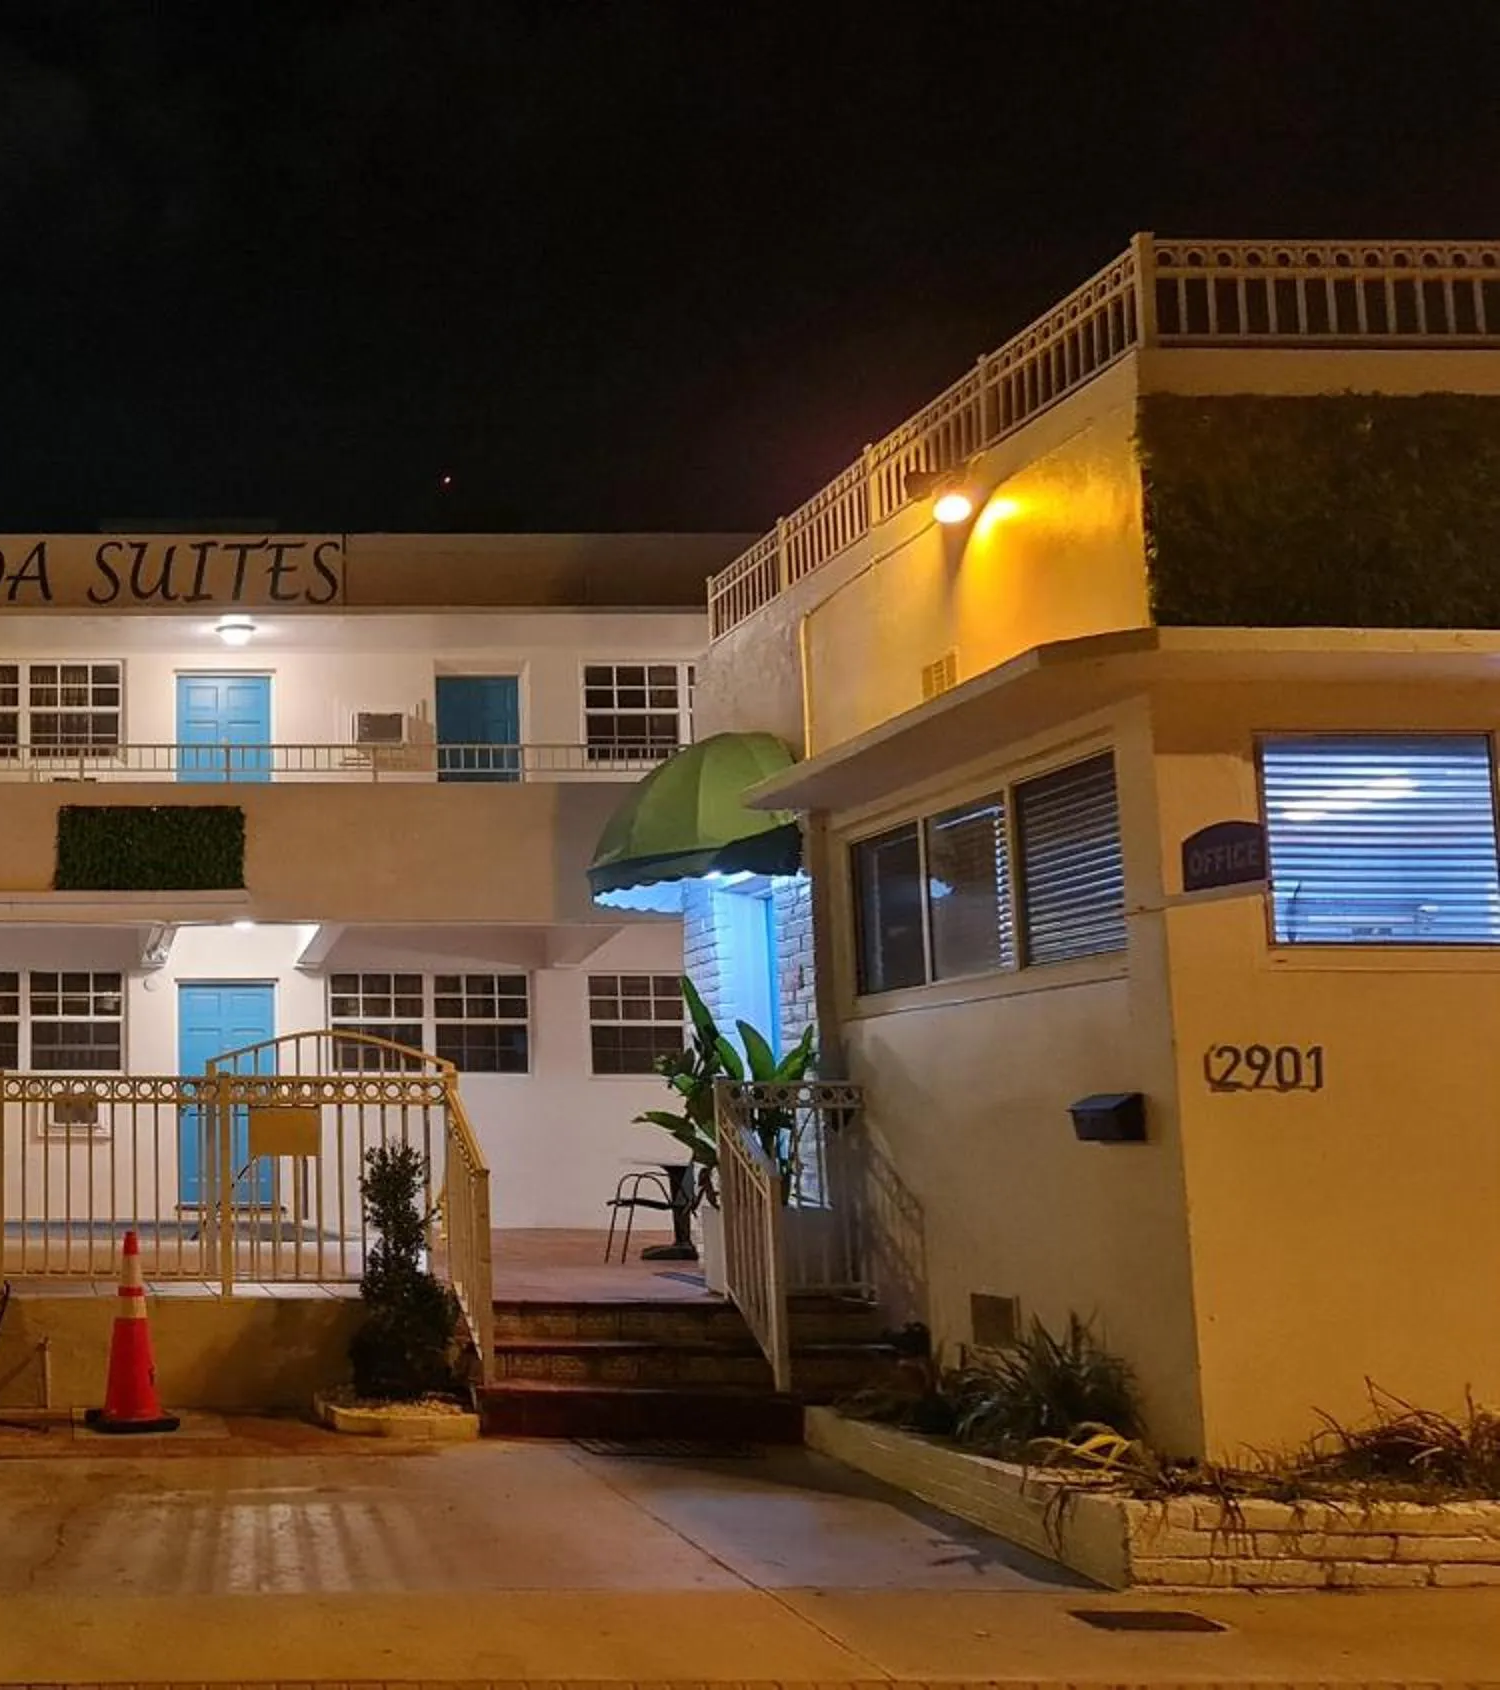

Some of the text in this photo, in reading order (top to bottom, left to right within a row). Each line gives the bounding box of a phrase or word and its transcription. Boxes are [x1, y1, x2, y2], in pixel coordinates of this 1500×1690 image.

[86, 538, 341, 604] SUITES
[1188, 839, 1261, 876] OFFICE
[1206, 1044, 1323, 1091] 2901
